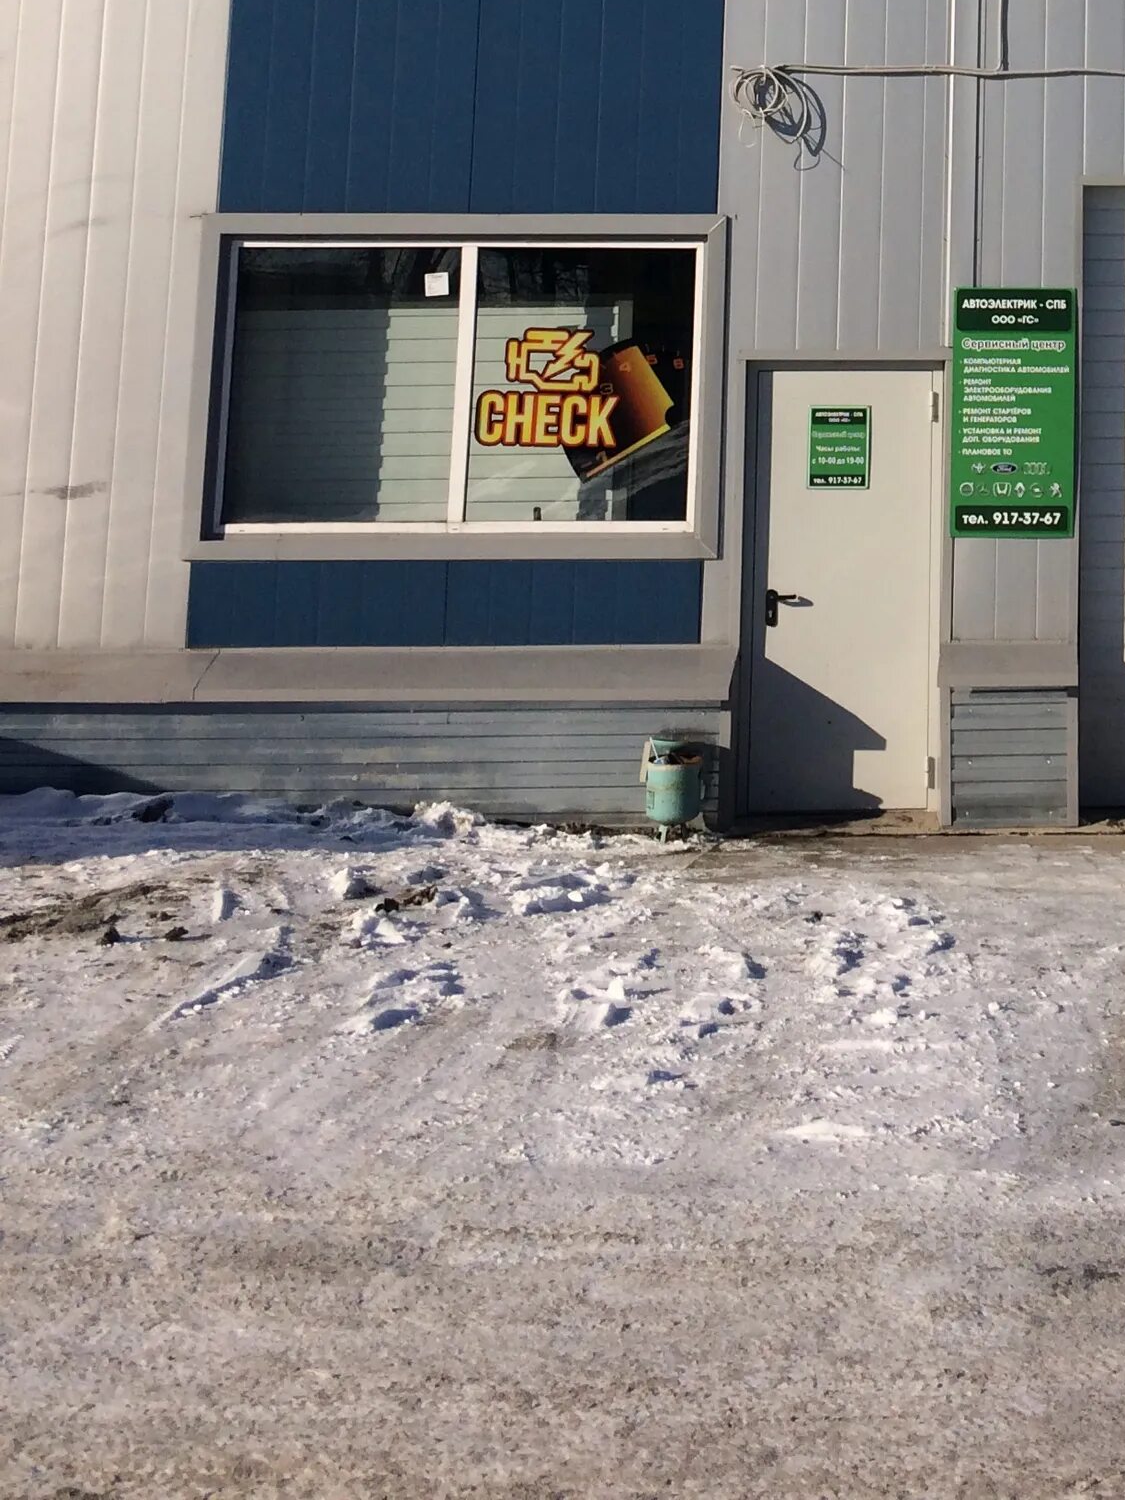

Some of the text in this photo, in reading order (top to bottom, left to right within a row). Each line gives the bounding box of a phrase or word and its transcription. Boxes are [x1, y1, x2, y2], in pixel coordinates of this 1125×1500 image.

[962, 299, 1037, 309] АВТОЭЛЕКТРИК
[1046, 299, 1067, 309] СПБ
[991, 315, 1039, 324] ООО «ГС»
[962, 338, 1066, 352] Сервисный центр
[1017, 365, 1069, 373] АВТОМОБИЛЕЙ
[476, 391, 620, 446] CHECK
[962, 512, 1061, 525] тел. 917-37-67
